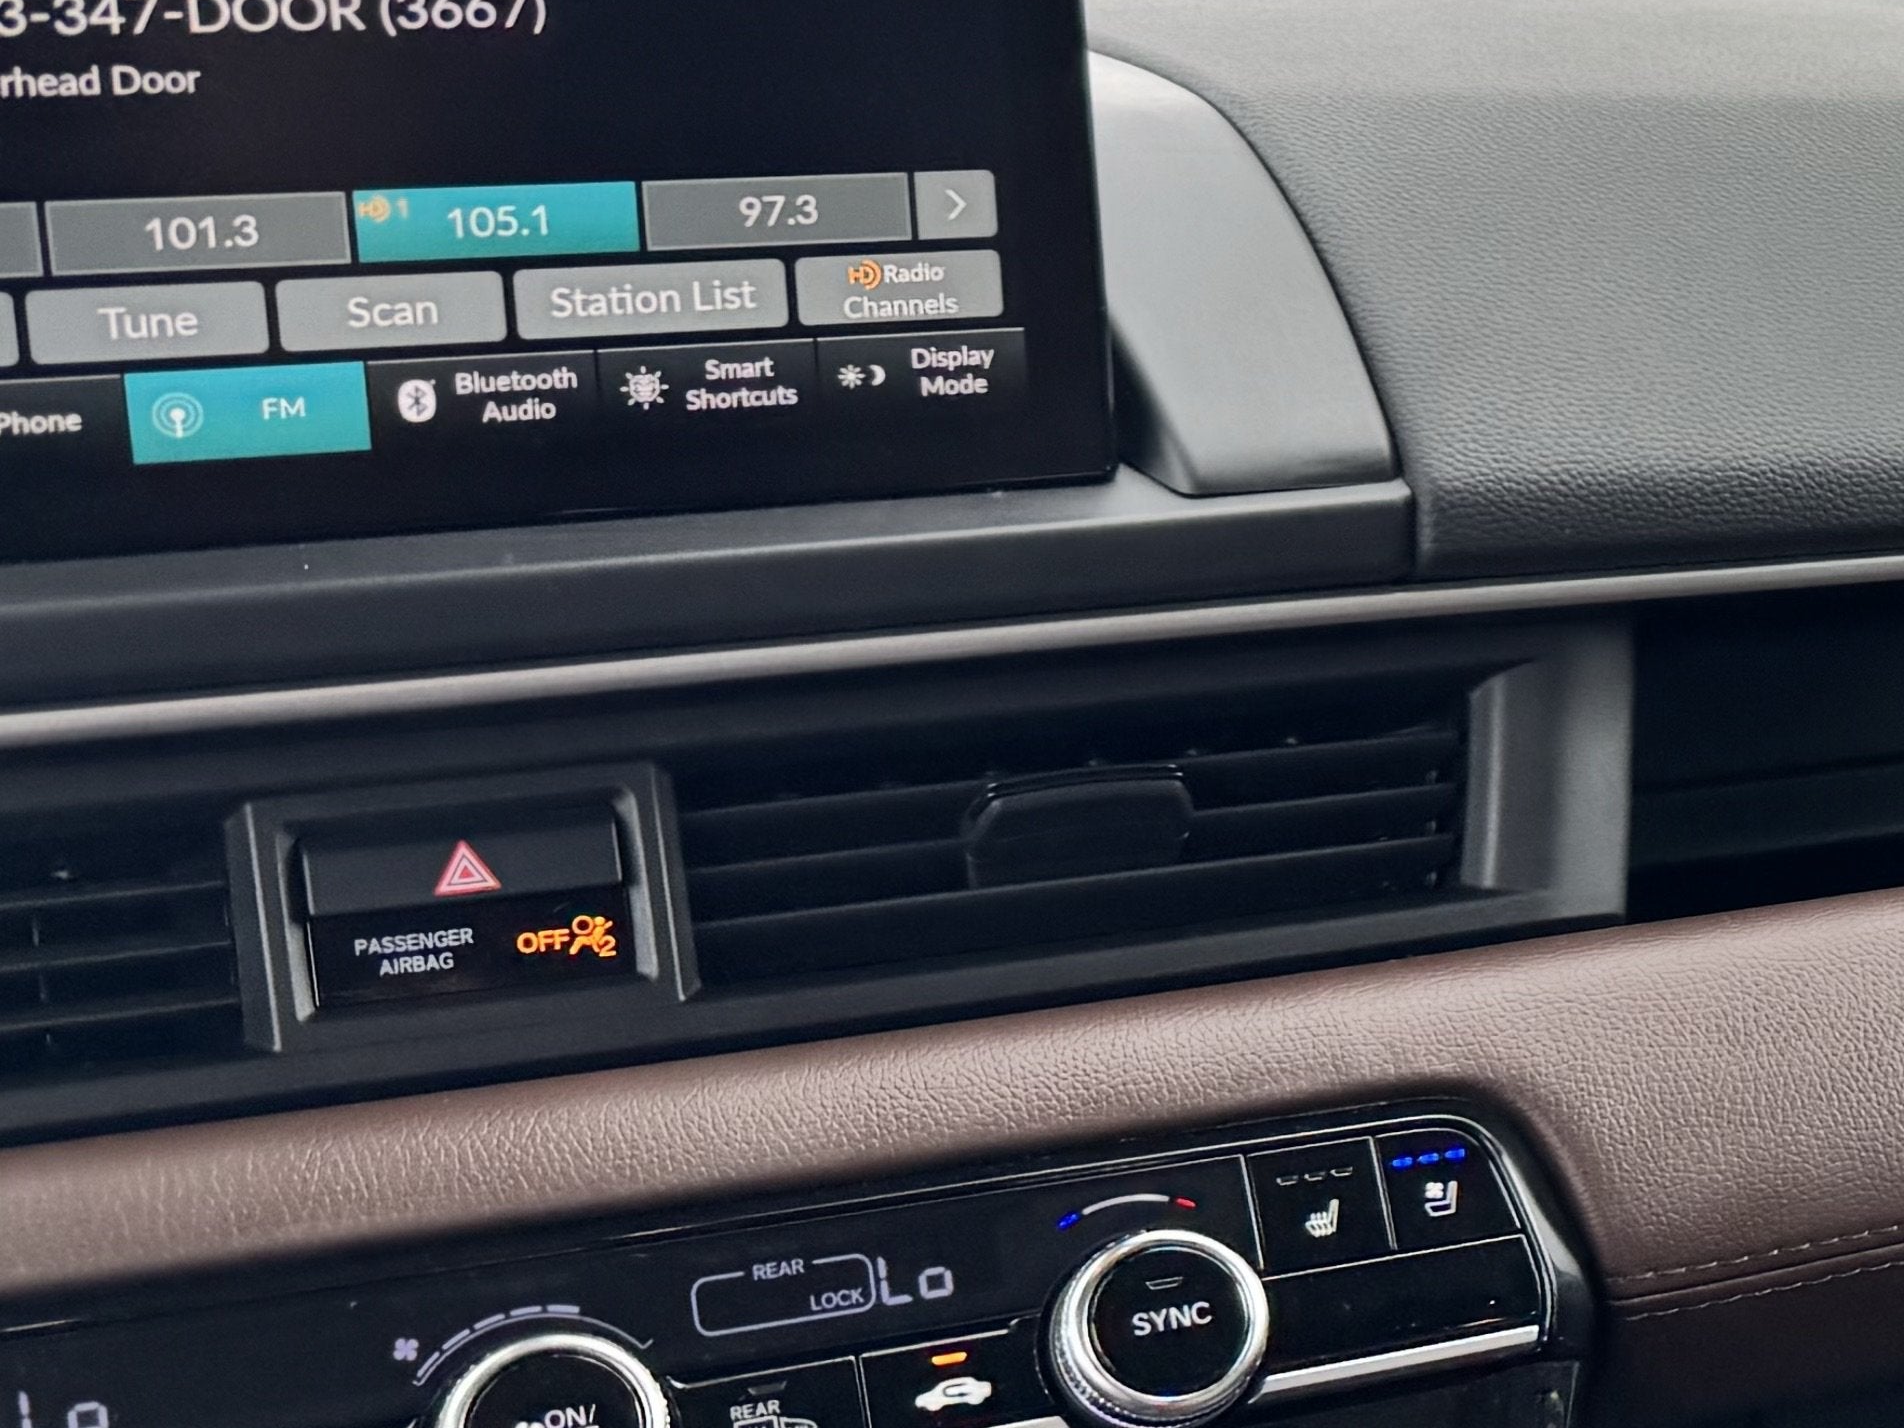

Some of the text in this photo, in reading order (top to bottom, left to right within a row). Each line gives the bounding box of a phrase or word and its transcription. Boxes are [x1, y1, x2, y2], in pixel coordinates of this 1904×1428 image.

[111, 64, 201, 96] Door
[446, 205, 550, 239] 105.1
[738, 194, 819, 229] 97.3
[144, 214, 260, 252] 101.3
[883, 263, 946, 284] Radio
[347, 296, 439, 330] Scan
[550, 280, 758, 320] Station List
[843, 292, 960, 320] Channels
[97, 306, 199, 342] Tune
[705, 357, 774, 380] Smart
[911, 345, 995, 371] Display
[455, 366, 578, 396] Bluetooth
[921, 374, 989, 397] Mode
[261, 397, 306, 421] FM
[482, 398, 556, 424] Audio
[686, 385, 799, 412] Shortcuts
[354, 927, 474, 956] PASSENGER
[516, 928, 570, 954] OFF
[379, 952, 454, 977] AIRBAG
[752, 1258, 805, 1281] REAR
[877, 1256, 954, 1307] Lo
[809, 1286, 865, 1312] LOCK
[1132, 1301, 1214, 1337] SYNC
[730, 1399, 781, 1422] REAR
